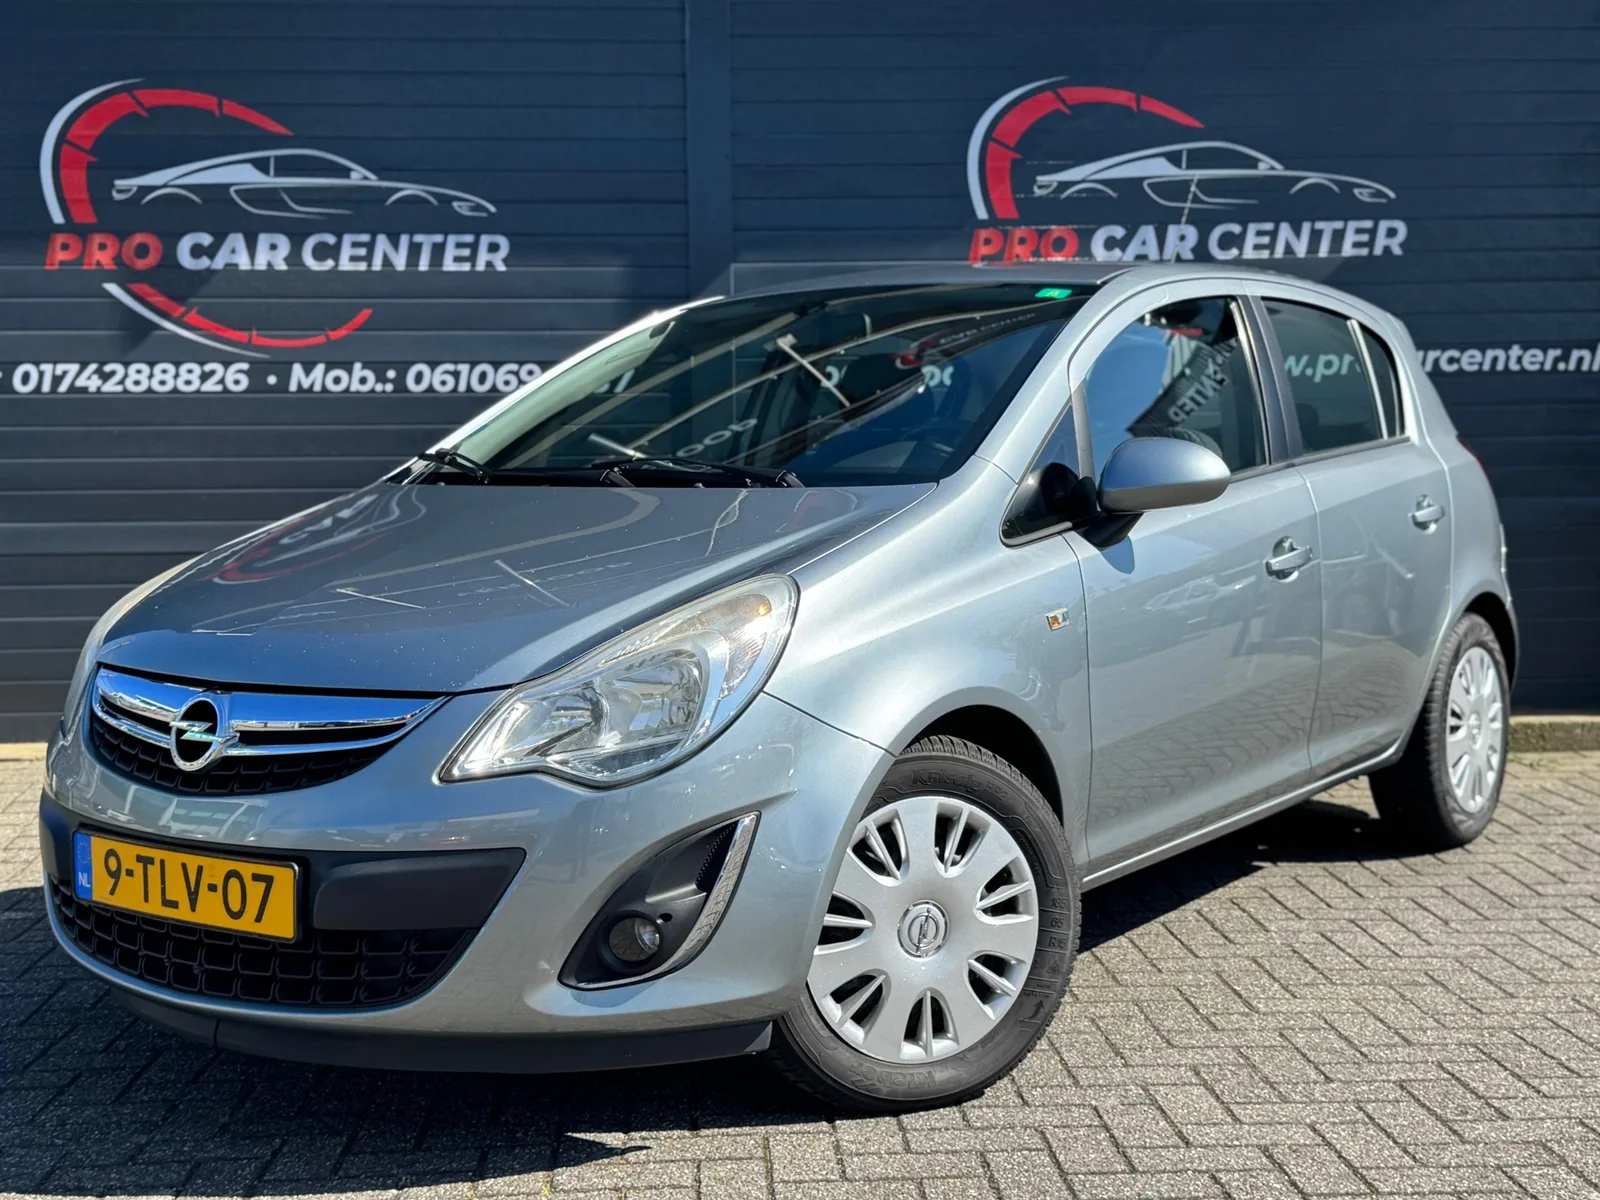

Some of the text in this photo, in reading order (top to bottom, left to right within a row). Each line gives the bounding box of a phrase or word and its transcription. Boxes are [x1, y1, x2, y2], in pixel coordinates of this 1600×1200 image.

[45, 232, 511, 272] PRO CAR CENTER
[969, 219, 1408, 264] PRO CAR CENTER
[13, 362, 250, 394] 0174288826
[288, 362, 396, 394] Mob.:
[78, 871, 91, 888] NL
[103, 847, 275, 924] 9-TLV-07
